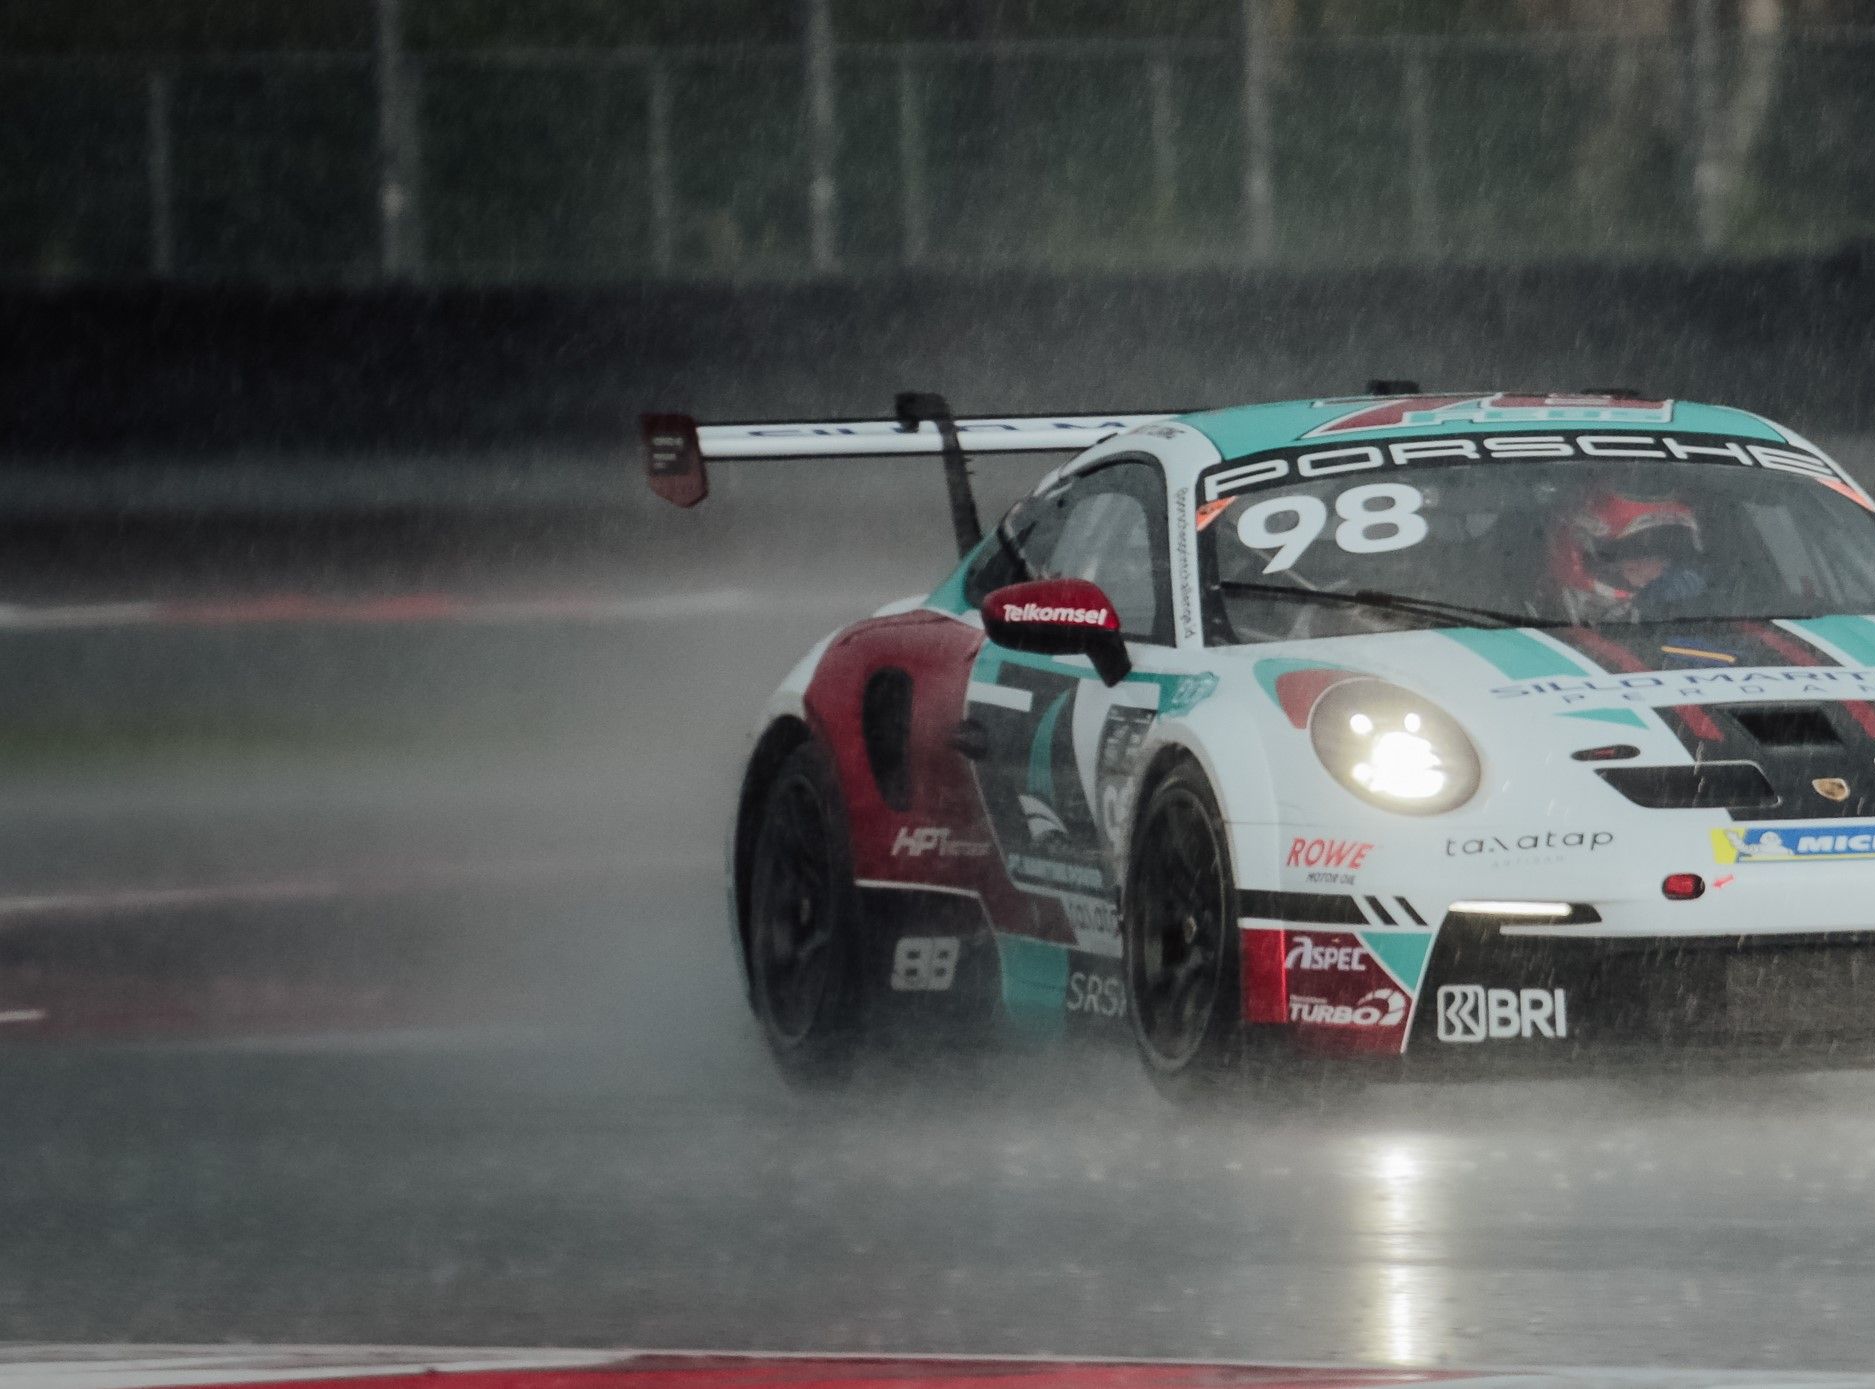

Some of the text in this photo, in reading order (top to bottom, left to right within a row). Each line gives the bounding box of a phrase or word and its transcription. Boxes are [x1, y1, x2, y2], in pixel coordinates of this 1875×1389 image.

[1204, 435, 1836, 502] PORSCHE
[1236, 482, 1429, 574] 98
[1003, 601, 1109, 626] Telkomsel
[1489, 677, 1663, 699] SILLO
[1285, 837, 1374, 871] ROWE
[1289, 1003, 1382, 1026] TURBO
[1487, 988, 1568, 1039] BRI
